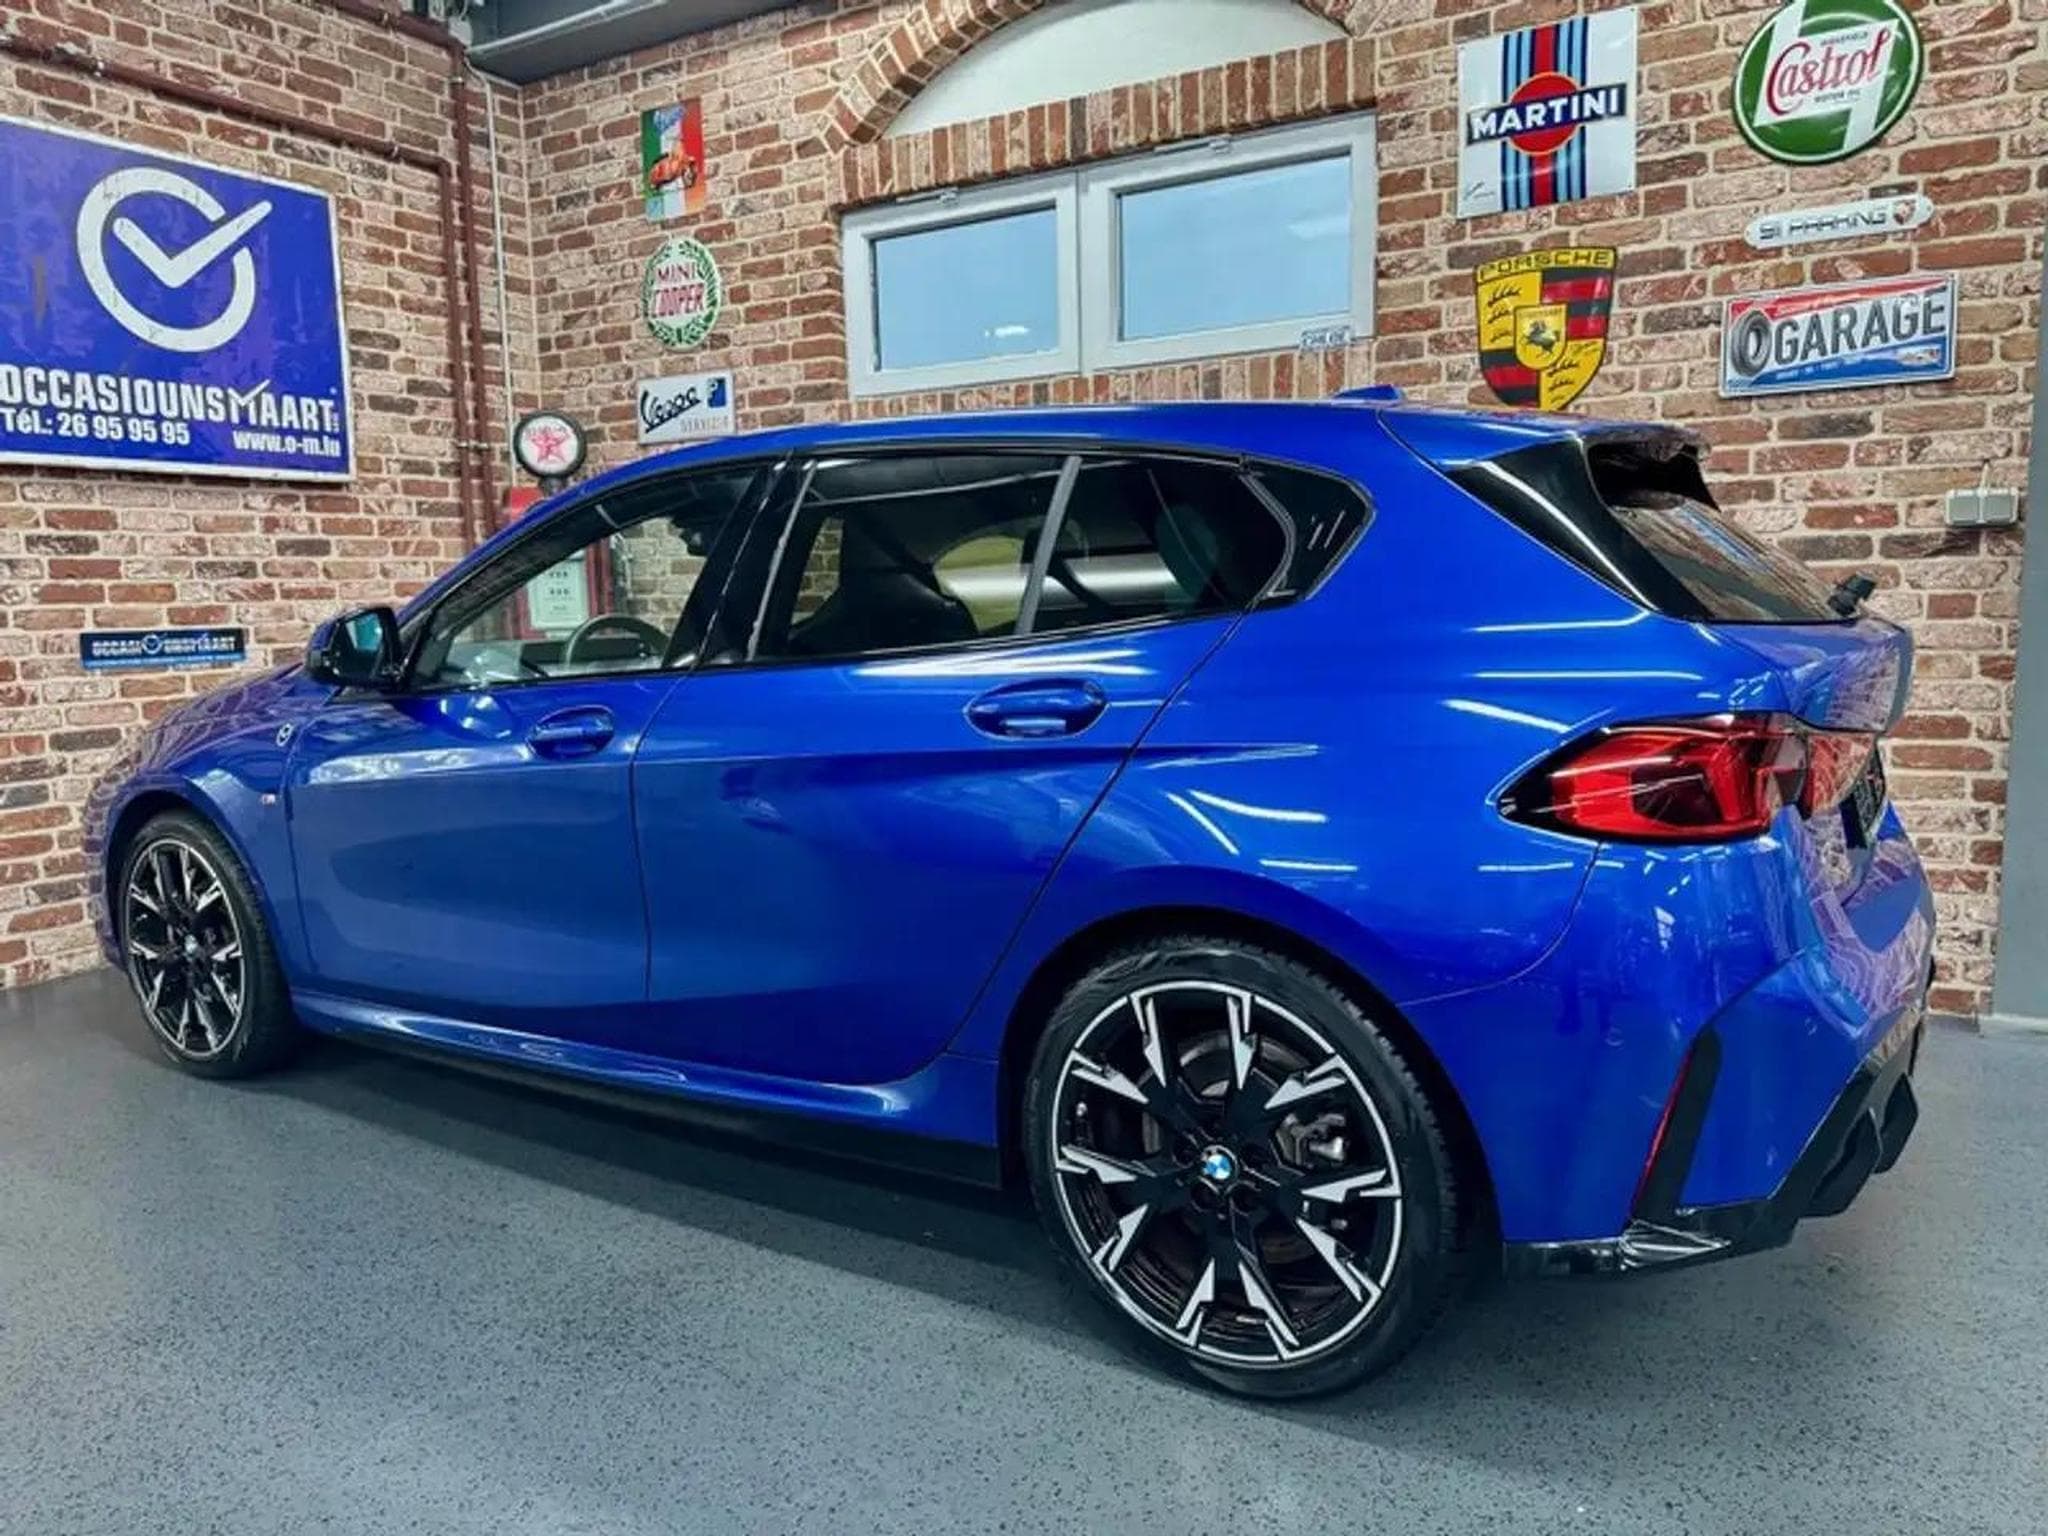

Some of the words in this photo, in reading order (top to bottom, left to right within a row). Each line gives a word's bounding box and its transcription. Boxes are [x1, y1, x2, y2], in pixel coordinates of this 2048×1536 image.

[1766, 27, 1891, 117] Castrol
[1470, 87, 1619, 140] MARTINI
[656, 261, 696, 282] MINI
[1480, 250, 1611, 281] PORSCHE
[651, 283, 705, 319] COOPER
[1774, 285, 1949, 366] GARAGE
[57, 411, 89, 438] 26
[92, 414, 124, 440] 95
[127, 417, 158, 444] 95
[161, 420, 191, 446] 95
[233, 430, 341, 457] www.o-m.lu
